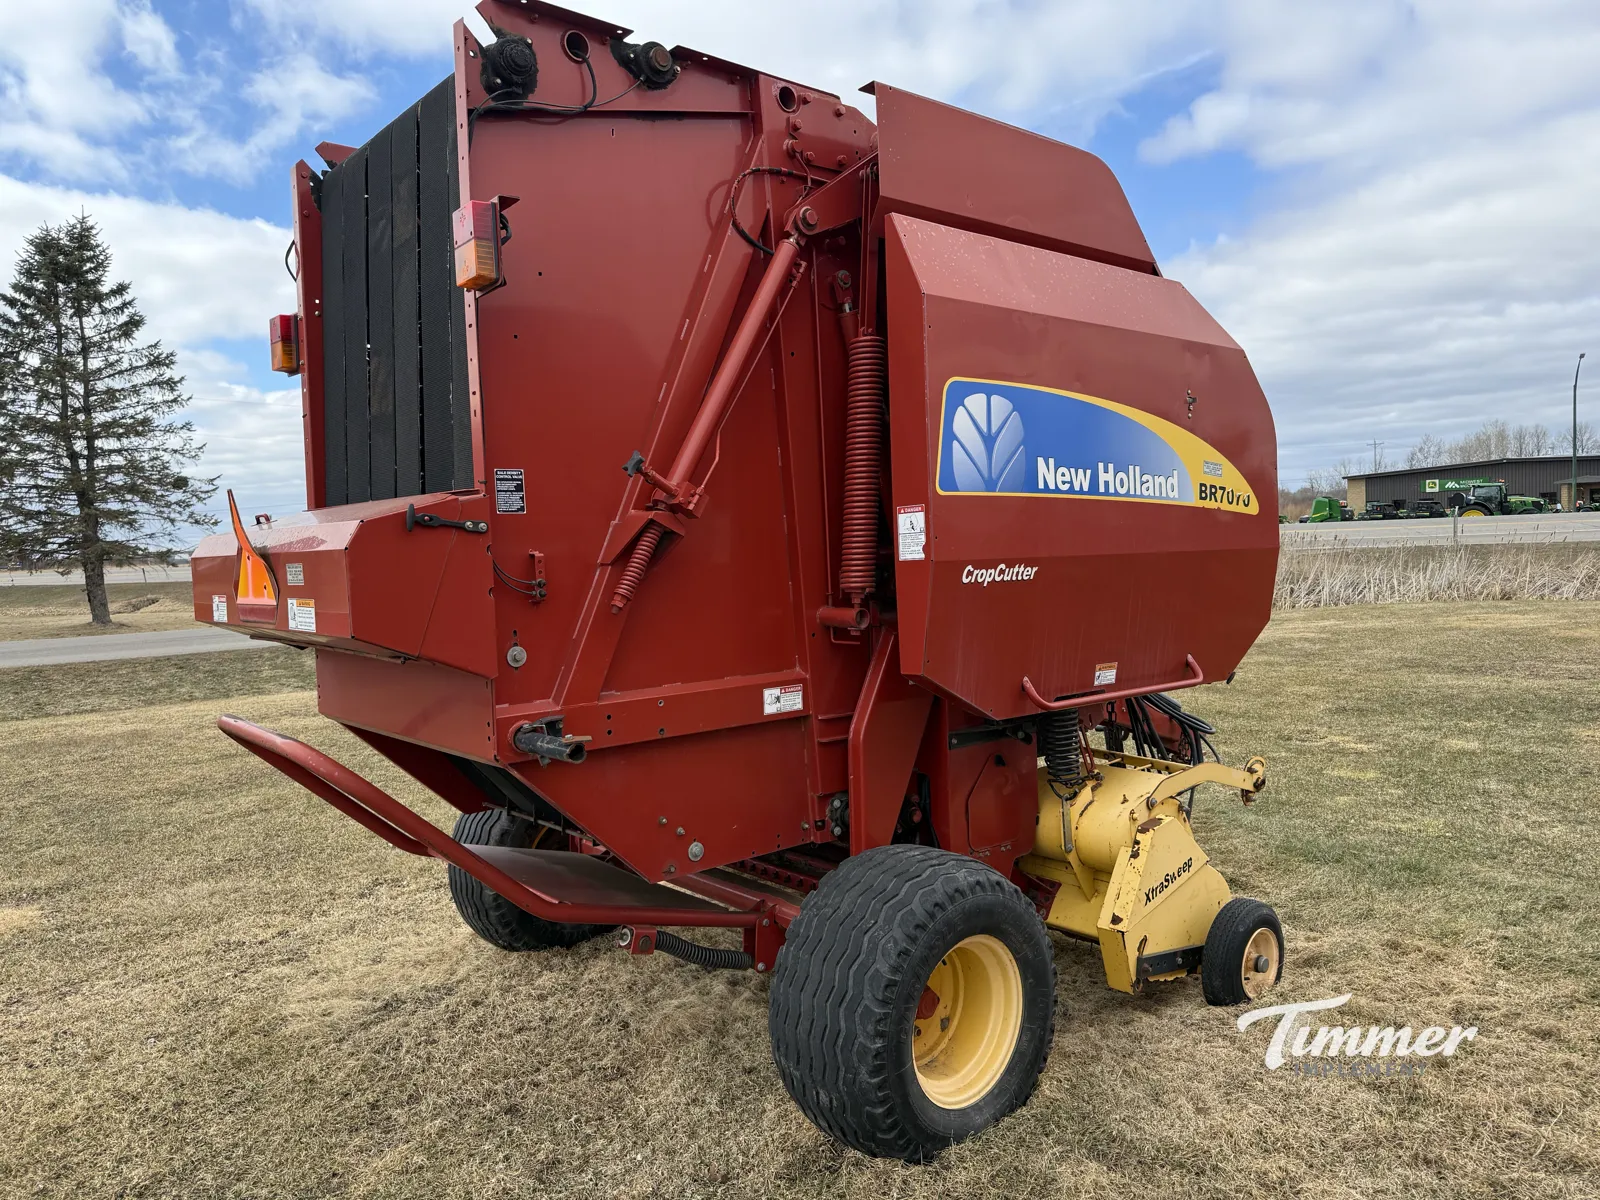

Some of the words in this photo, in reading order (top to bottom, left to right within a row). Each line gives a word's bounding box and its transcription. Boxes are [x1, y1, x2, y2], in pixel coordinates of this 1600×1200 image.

[1037, 456, 1091, 492] New
[1098, 462, 1179, 499] Holland
[962, 563, 1039, 587] CropCutter
[1144, 857, 1193, 906] XtraSweep
